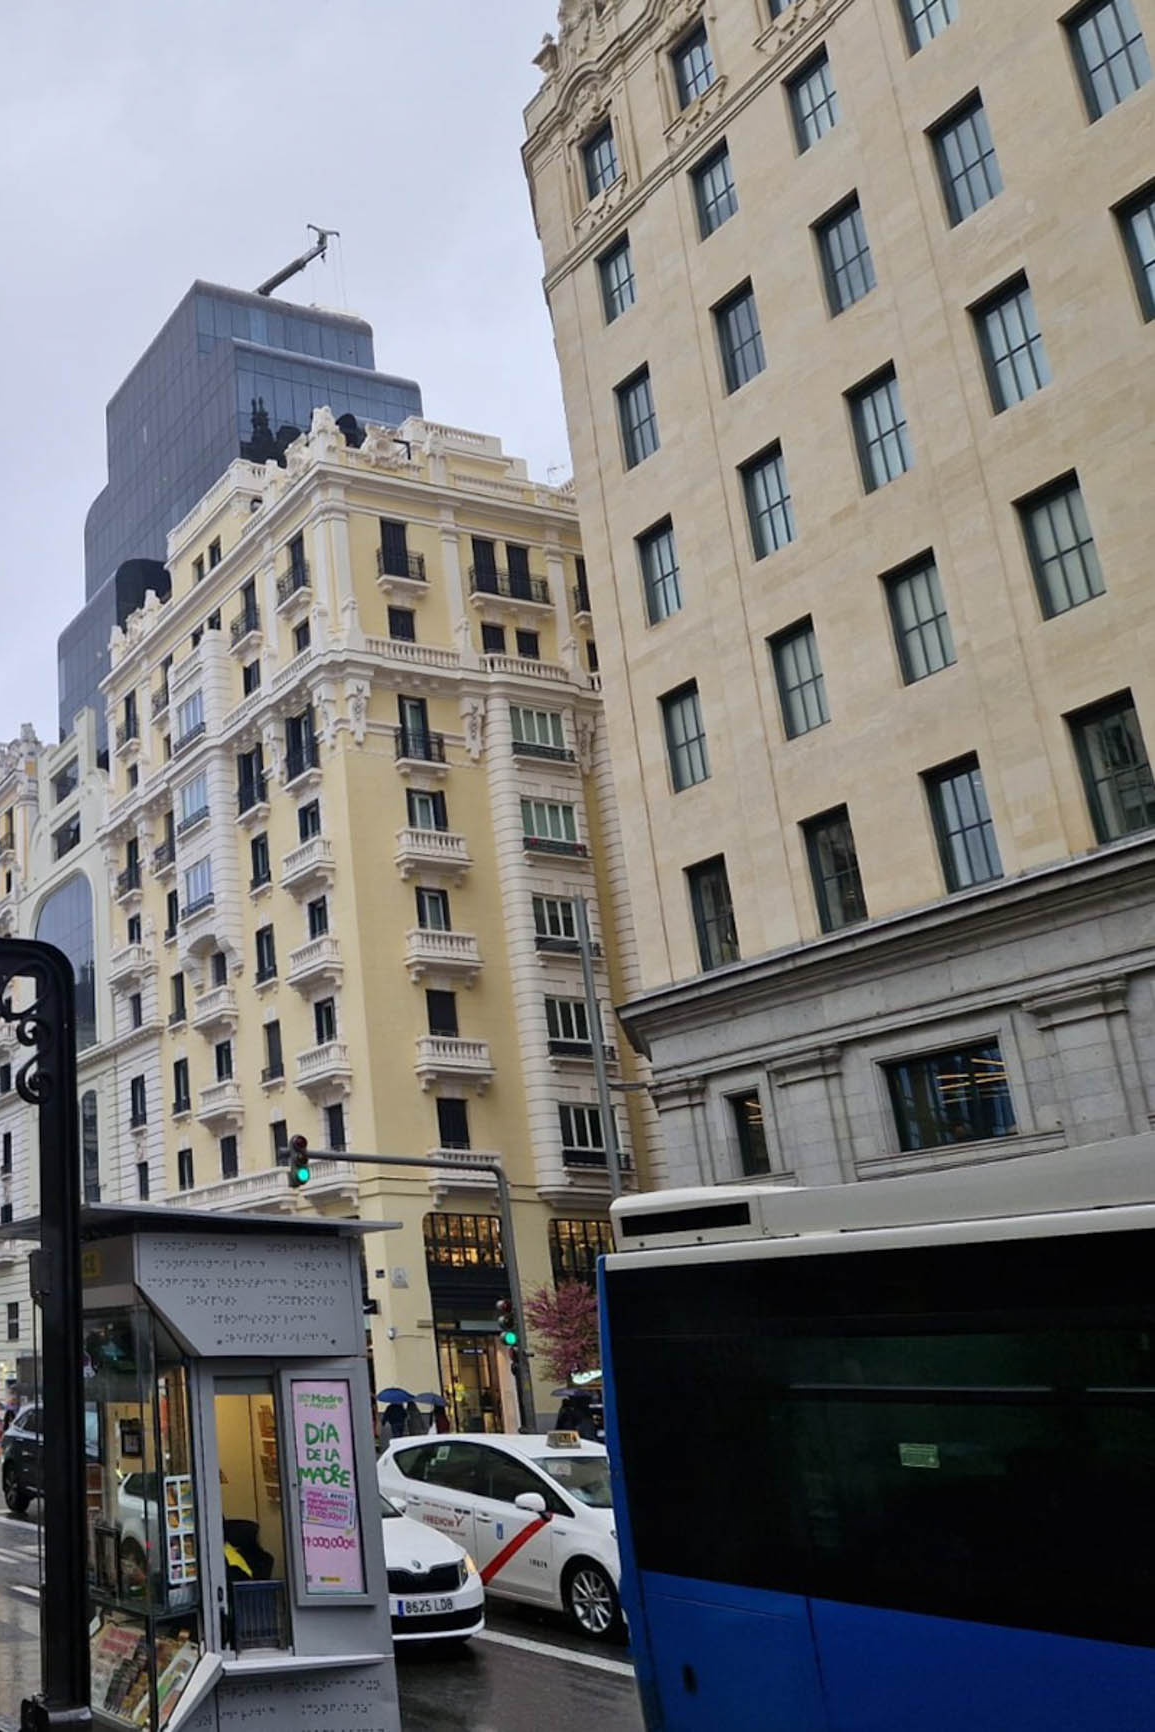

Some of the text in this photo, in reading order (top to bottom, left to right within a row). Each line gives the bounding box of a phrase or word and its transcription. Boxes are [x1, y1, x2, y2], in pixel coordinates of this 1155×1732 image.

[306, 1448, 340, 1462] DE LA
[297, 1463, 351, 1488] MADRE
[405, 1599, 432, 1614] 8625
